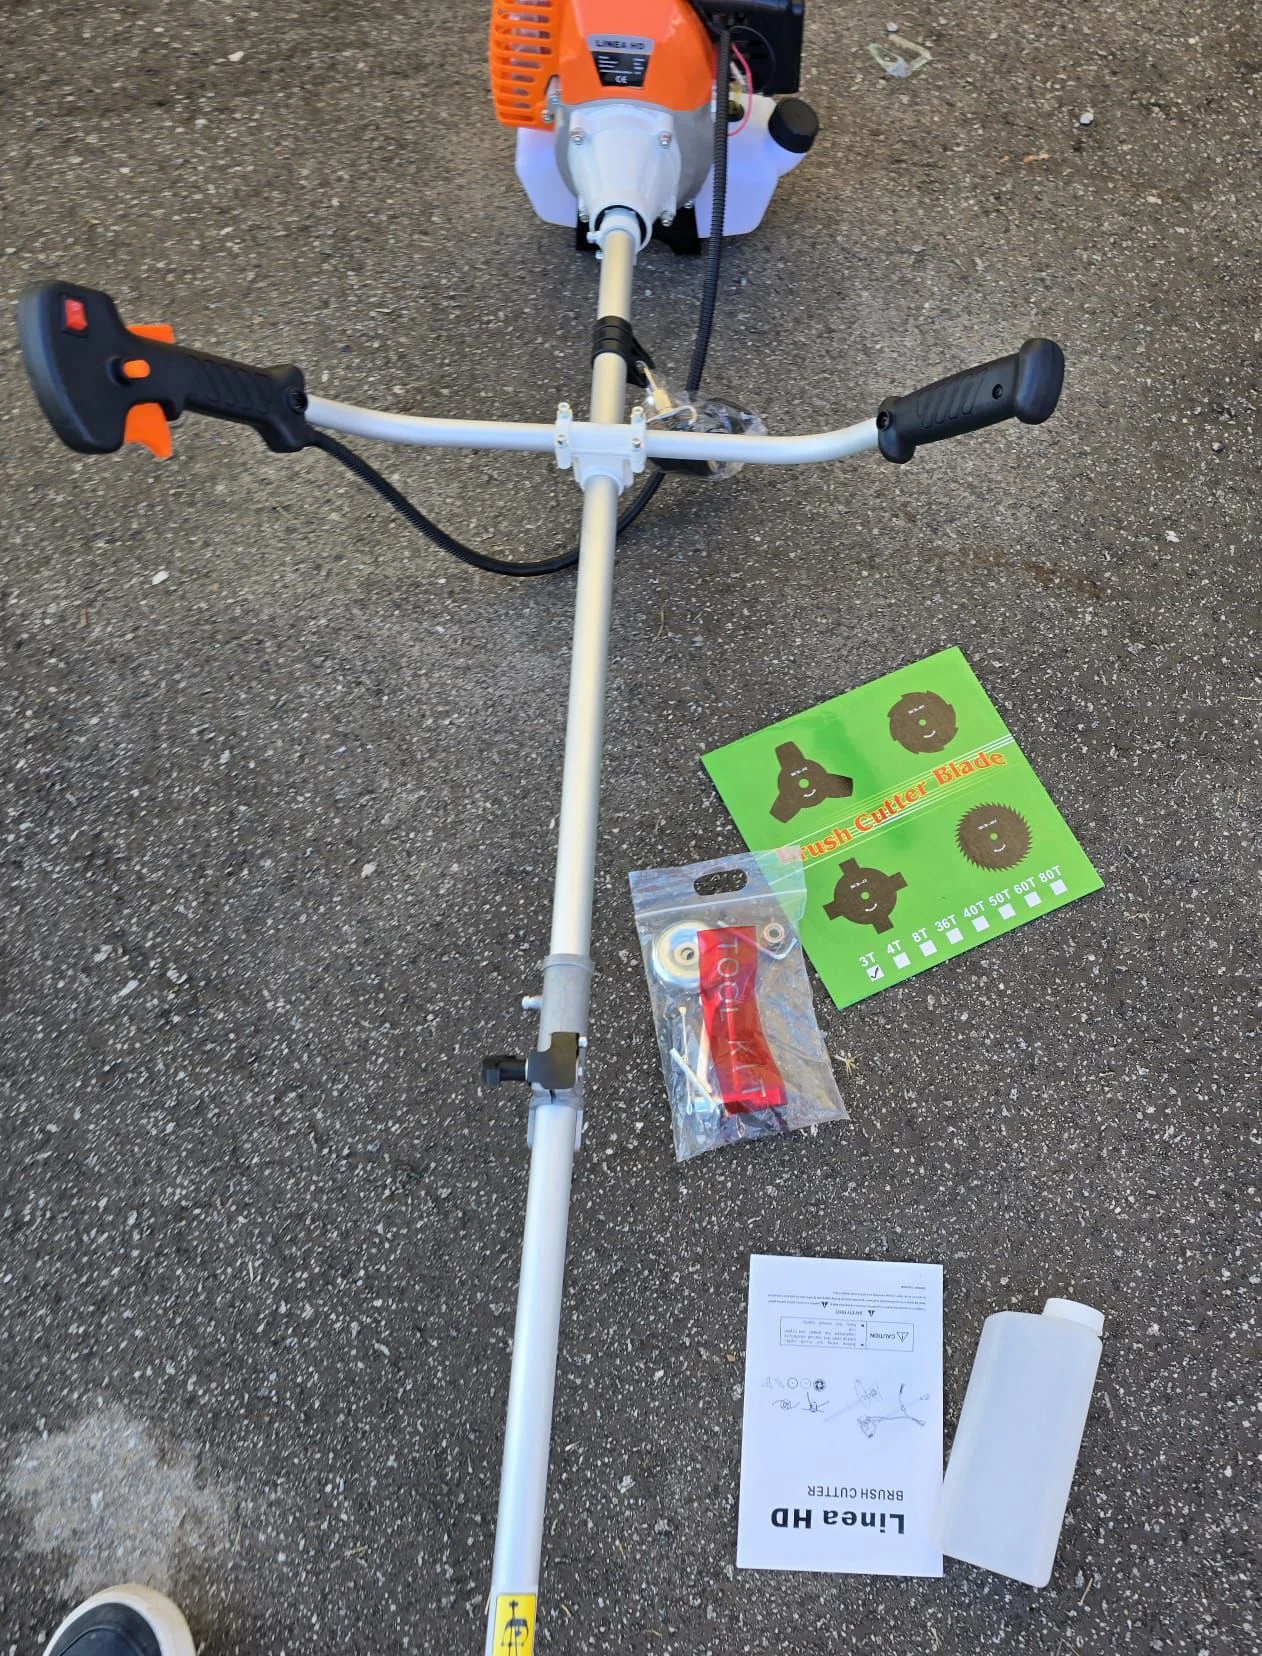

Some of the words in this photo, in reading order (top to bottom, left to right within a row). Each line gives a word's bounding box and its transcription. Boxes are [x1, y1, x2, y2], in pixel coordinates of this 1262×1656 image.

[854, 781, 929, 833] Cutter
[932, 751, 1008, 786] Blade
[858, 951, 878, 968] 3T
[886, 939, 903, 955] 4T
[911, 927, 930, 943] 8T
[934, 914, 958, 932] 36T
[963, 901, 986, 919] 40T
[988, 888, 1011, 907] 50T
[1013, 876, 1037, 895] 60T
[1038, 865, 1063, 883] 80T
[717, 937, 740, 1022] TOOL
[727, 1040, 767, 1098] KIT
[869, 1332, 896, 1340] CAUTION
[807, 1485, 858, 1499] CUTTER
[861, 1488, 904, 1500] BRUSH
[770, 1507, 813, 1530] HD
[823, 1509, 905, 1535] Linea
